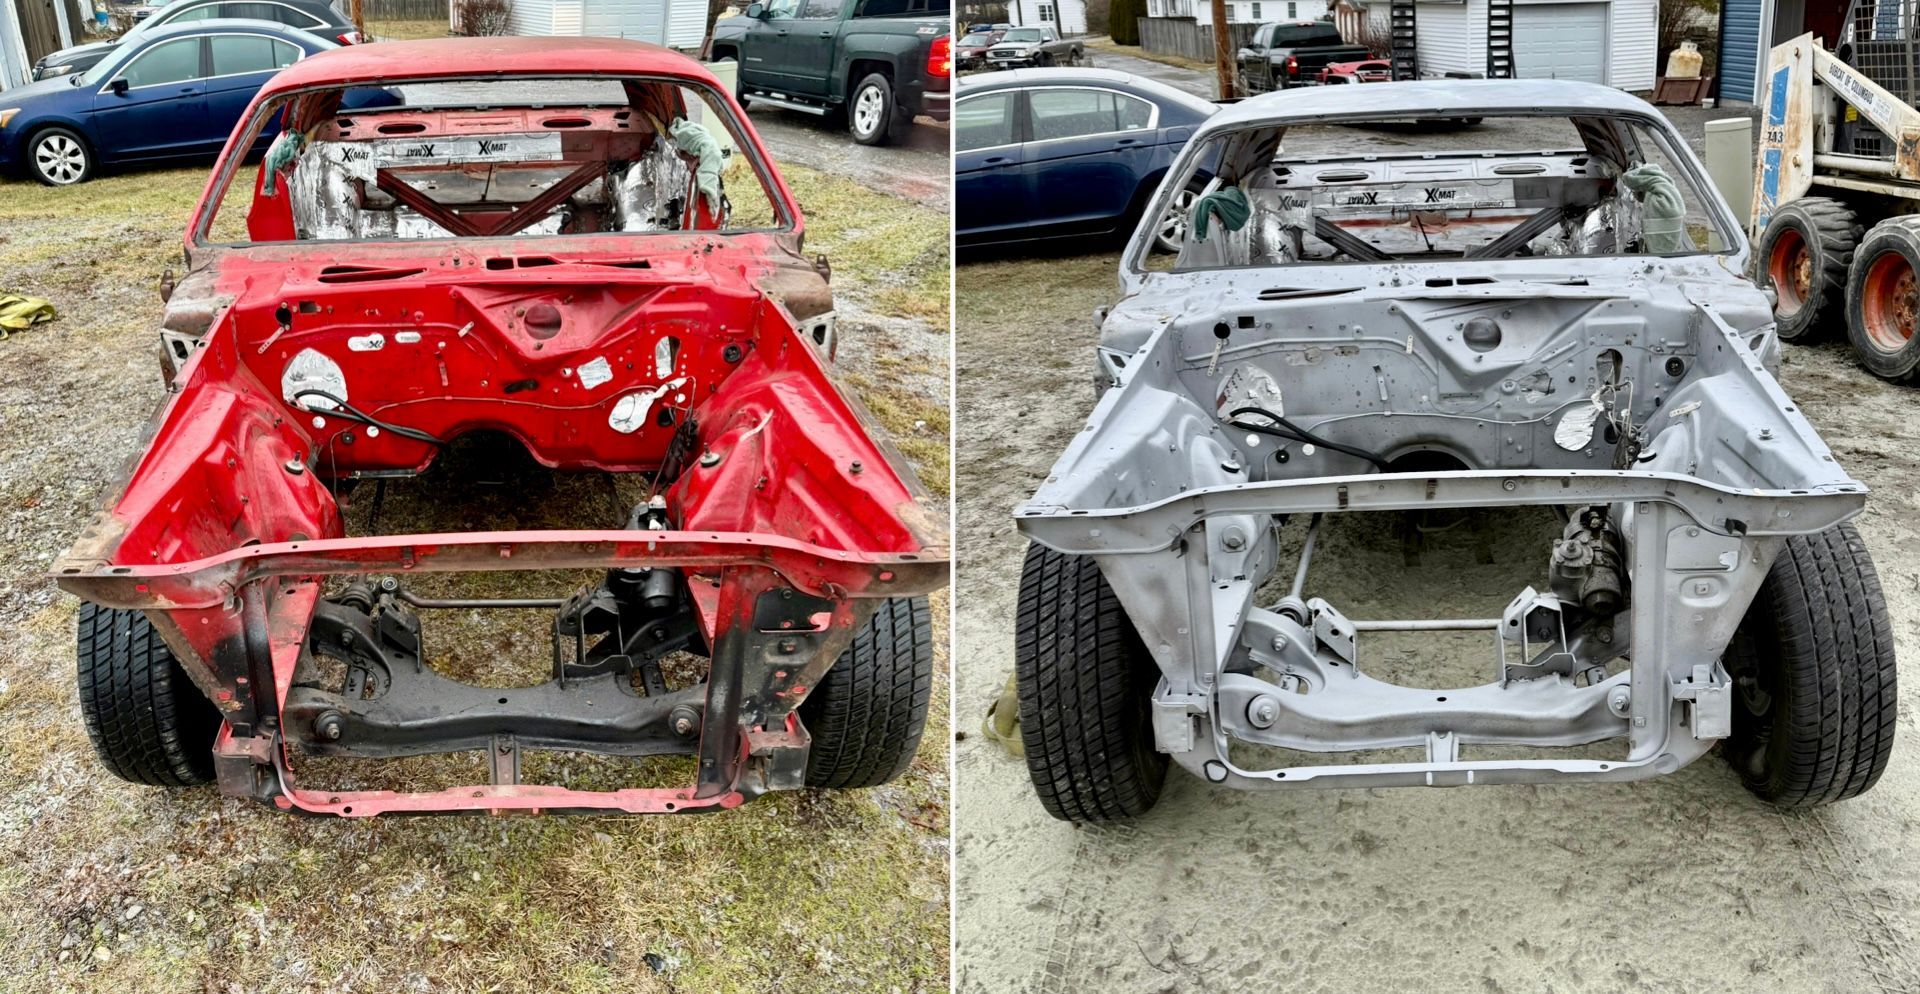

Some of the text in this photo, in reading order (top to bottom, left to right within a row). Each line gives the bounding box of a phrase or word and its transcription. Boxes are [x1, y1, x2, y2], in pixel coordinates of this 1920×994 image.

[1829, 62, 1845, 81] BOBCAT
[1844, 74, 1852, 87] OF
[1851, 79, 1874, 105] COLUMBUS
